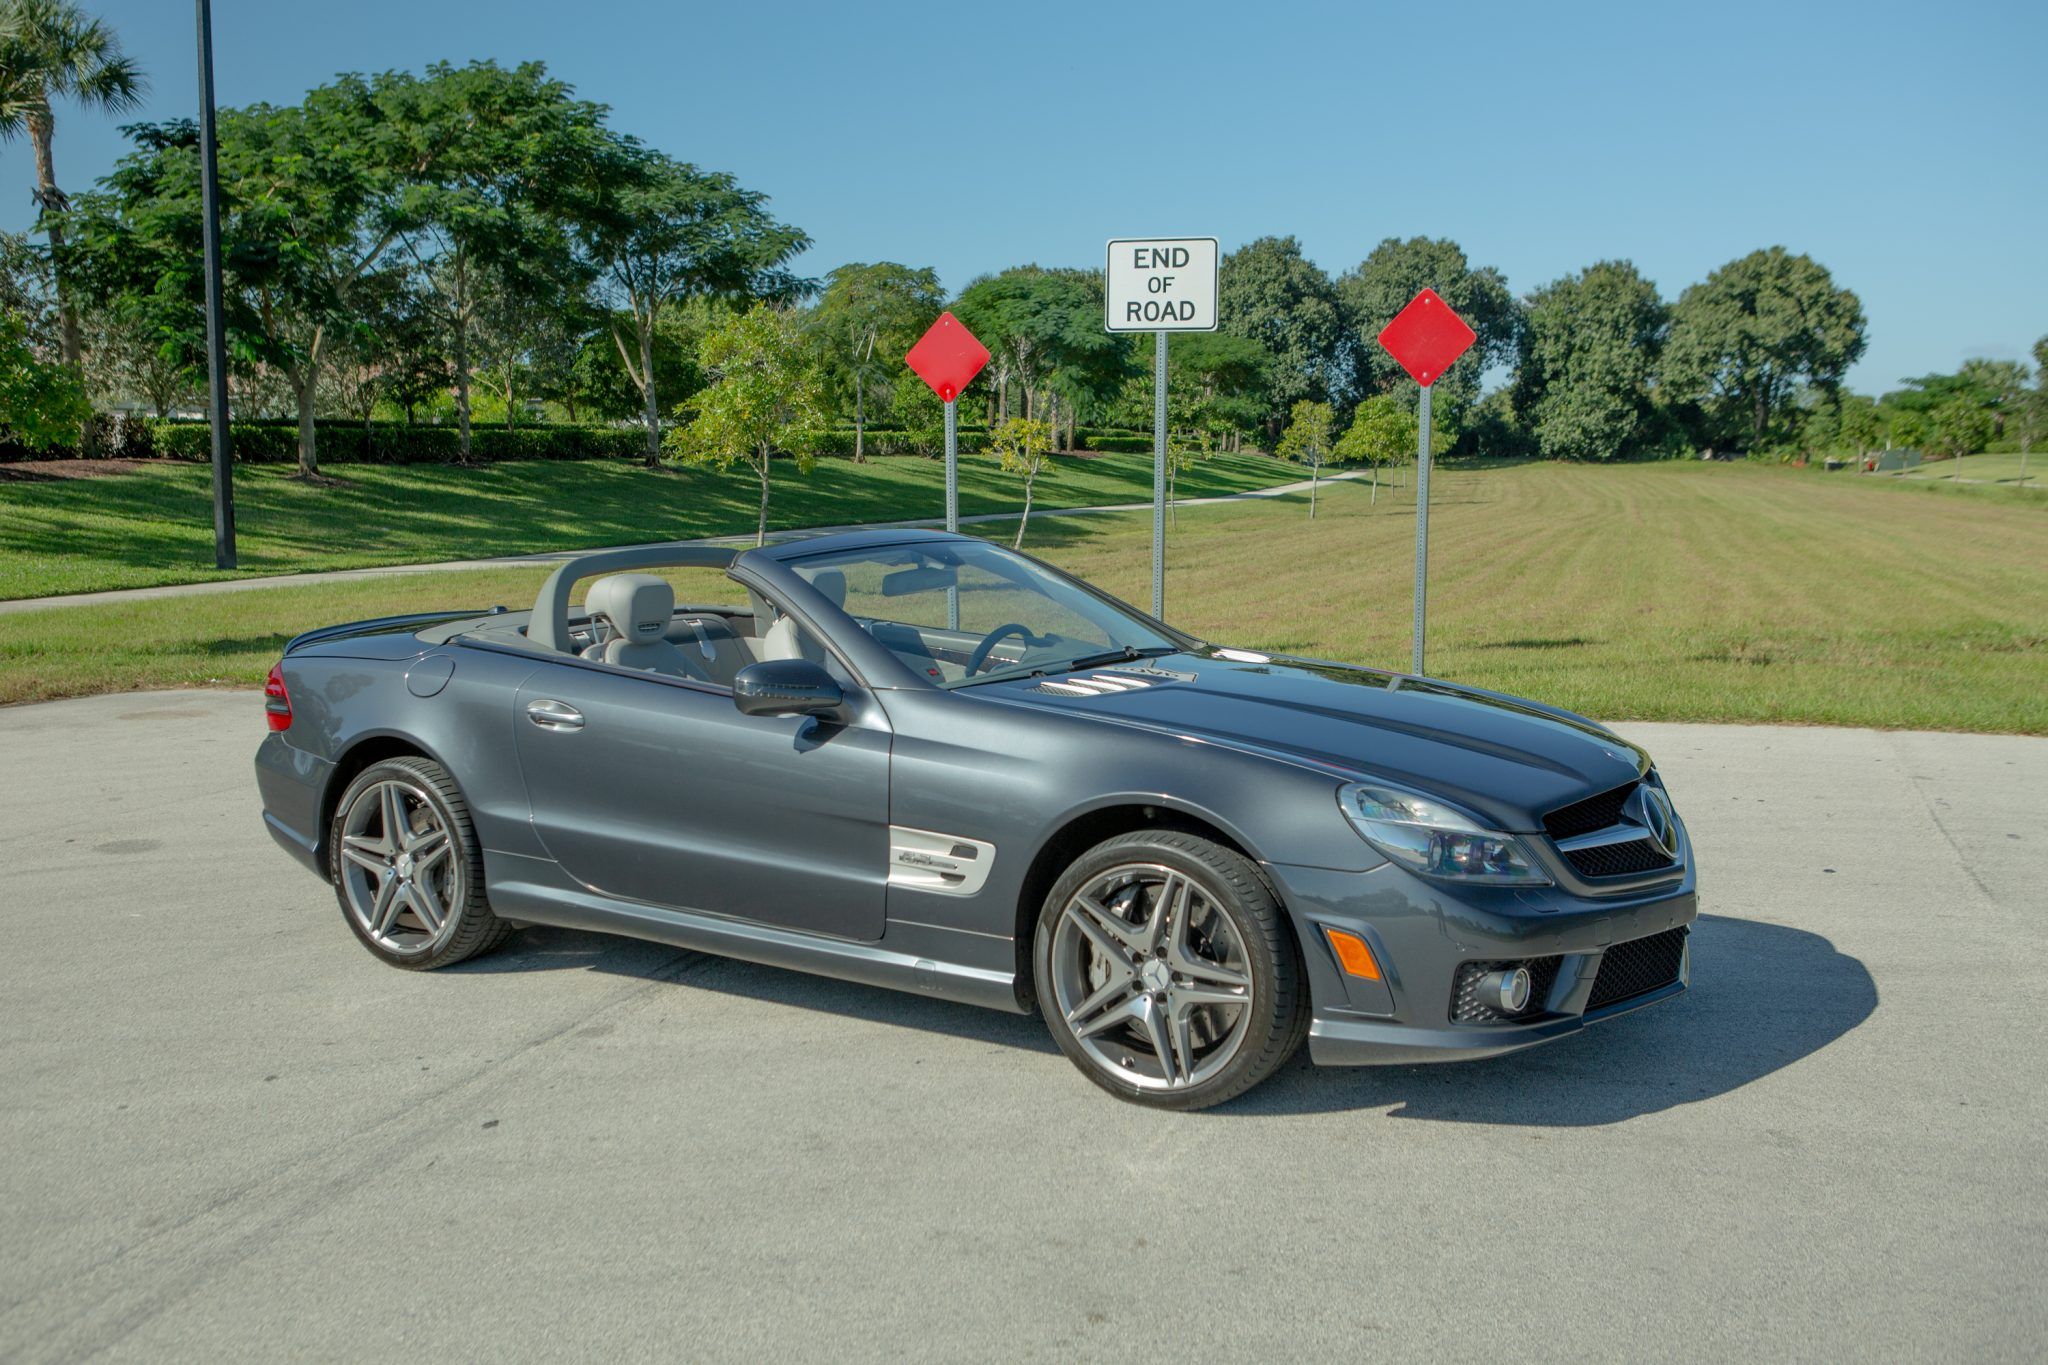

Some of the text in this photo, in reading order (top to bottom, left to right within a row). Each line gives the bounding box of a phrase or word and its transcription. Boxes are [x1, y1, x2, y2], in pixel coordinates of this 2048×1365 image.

[1134, 247, 1190, 269] END
[1147, 276, 1175, 294] OF
[1126, 300, 1196, 322] ROAD
